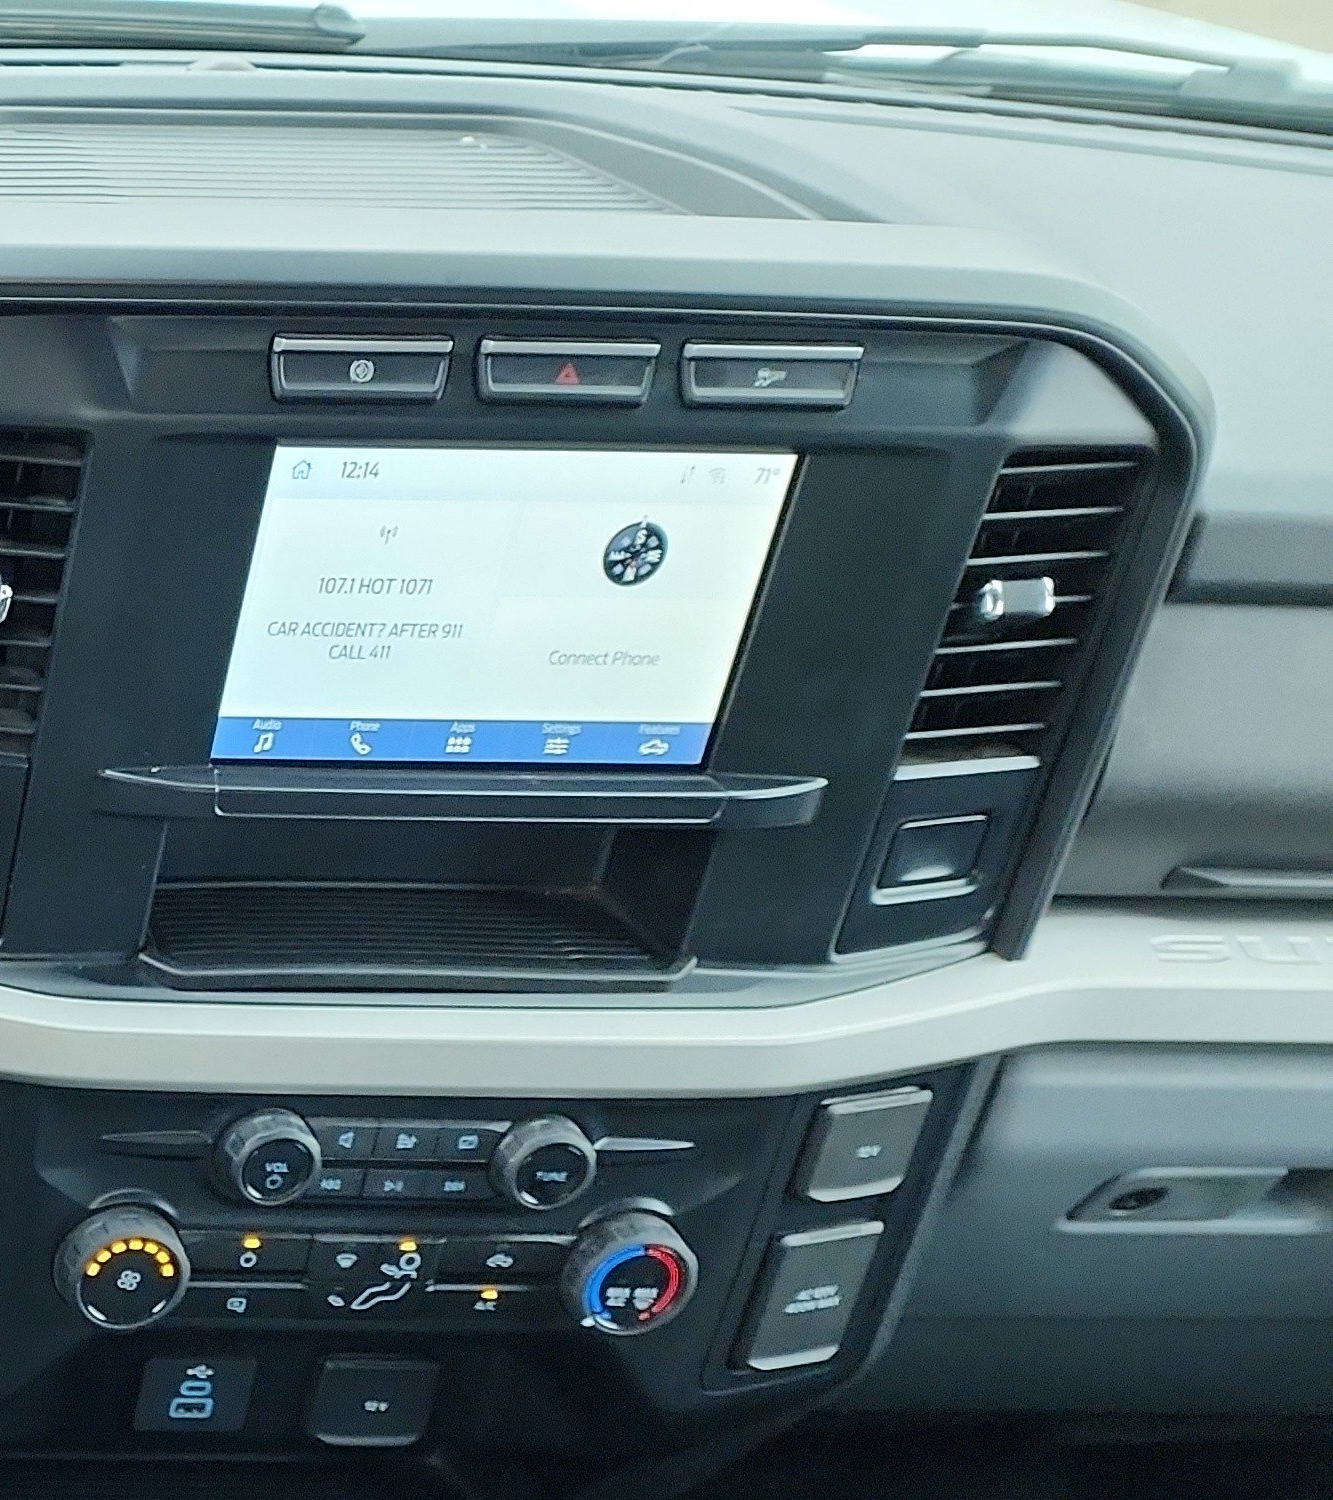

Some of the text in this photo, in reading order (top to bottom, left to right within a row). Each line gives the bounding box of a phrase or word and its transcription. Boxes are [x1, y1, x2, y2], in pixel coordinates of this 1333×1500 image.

[340, 461, 381, 479] 12:14
[317, 577, 434, 595] 107.1 HOT 1071
[267, 621, 463, 639] CAR ACCIDENT? AFTER 911
[328, 644, 392, 660] CALL 411
[548, 650, 662, 666] Connect Phone
